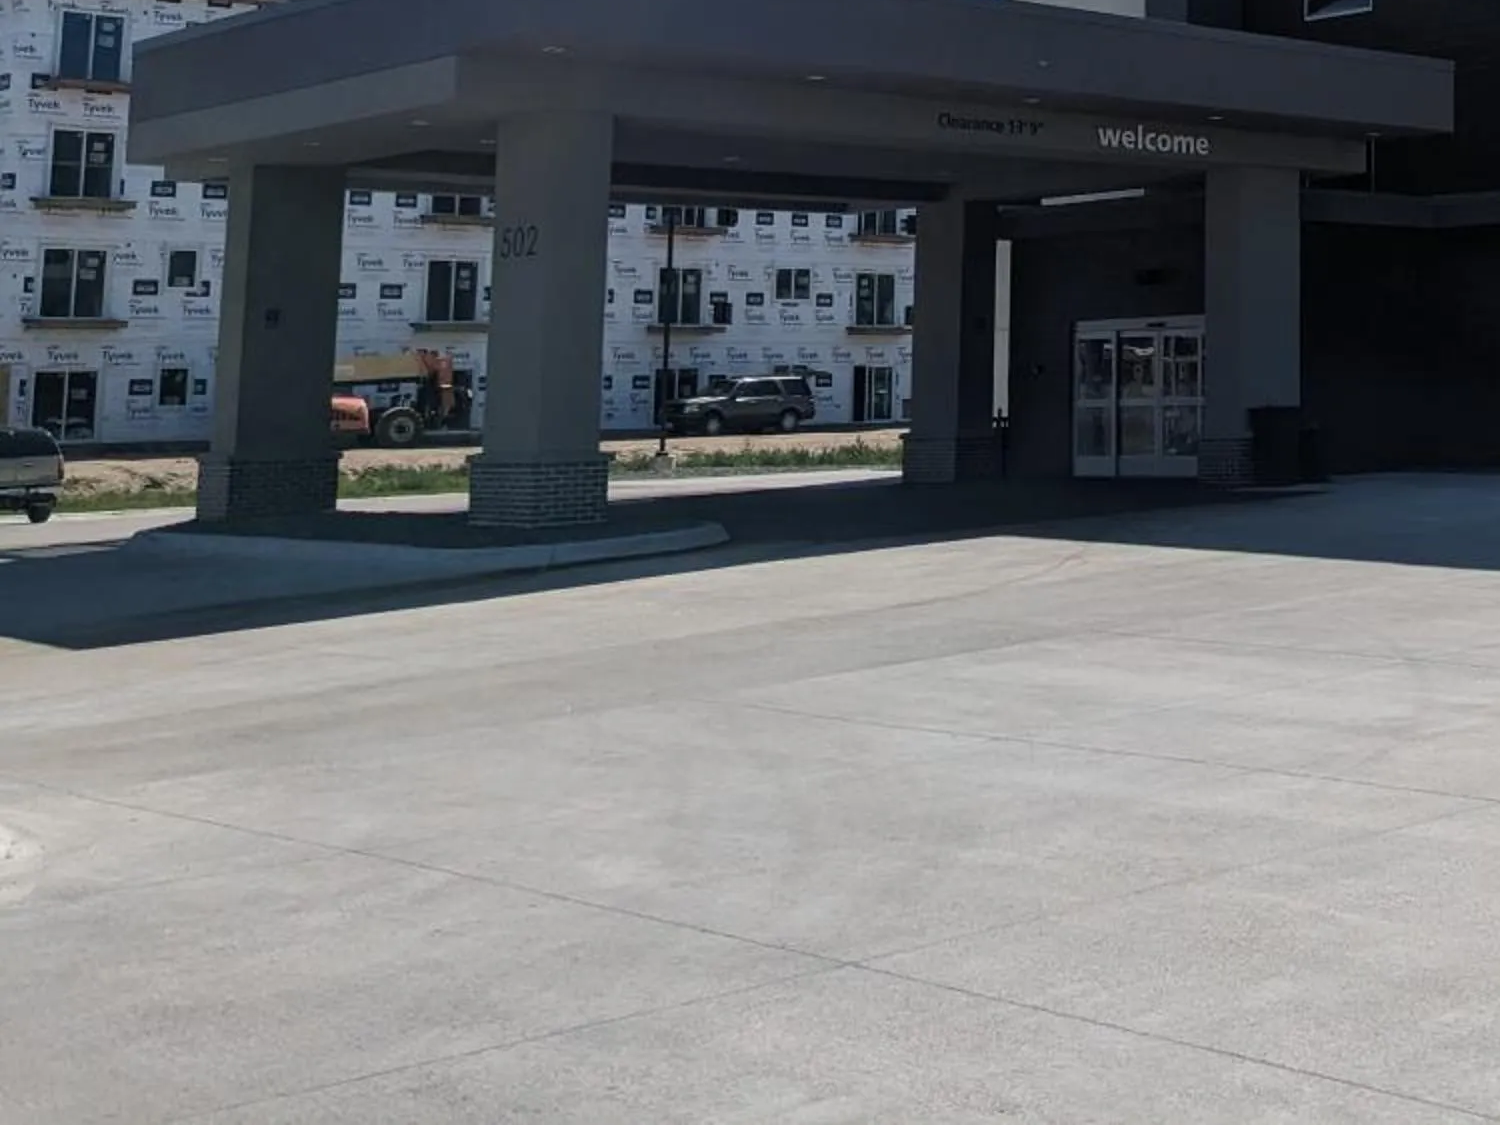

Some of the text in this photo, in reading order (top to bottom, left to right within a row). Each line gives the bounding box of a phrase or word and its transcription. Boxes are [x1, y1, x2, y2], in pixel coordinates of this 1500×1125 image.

[28, 98, 62, 110] Tyvek
[83, 102, 114, 114] Tyvek
[1098, 124, 1209, 155] welcome
[149, 205, 178, 217] Tyvek
[500, 224, 539, 260] 502
[129, 303, 159, 315] Tyvek
[182, 304, 212, 315] Tyvek
[47, 350, 79, 362] Tyvek
[102, 350, 133, 363] Tyvek
[156, 350, 185, 361] Tyvek
